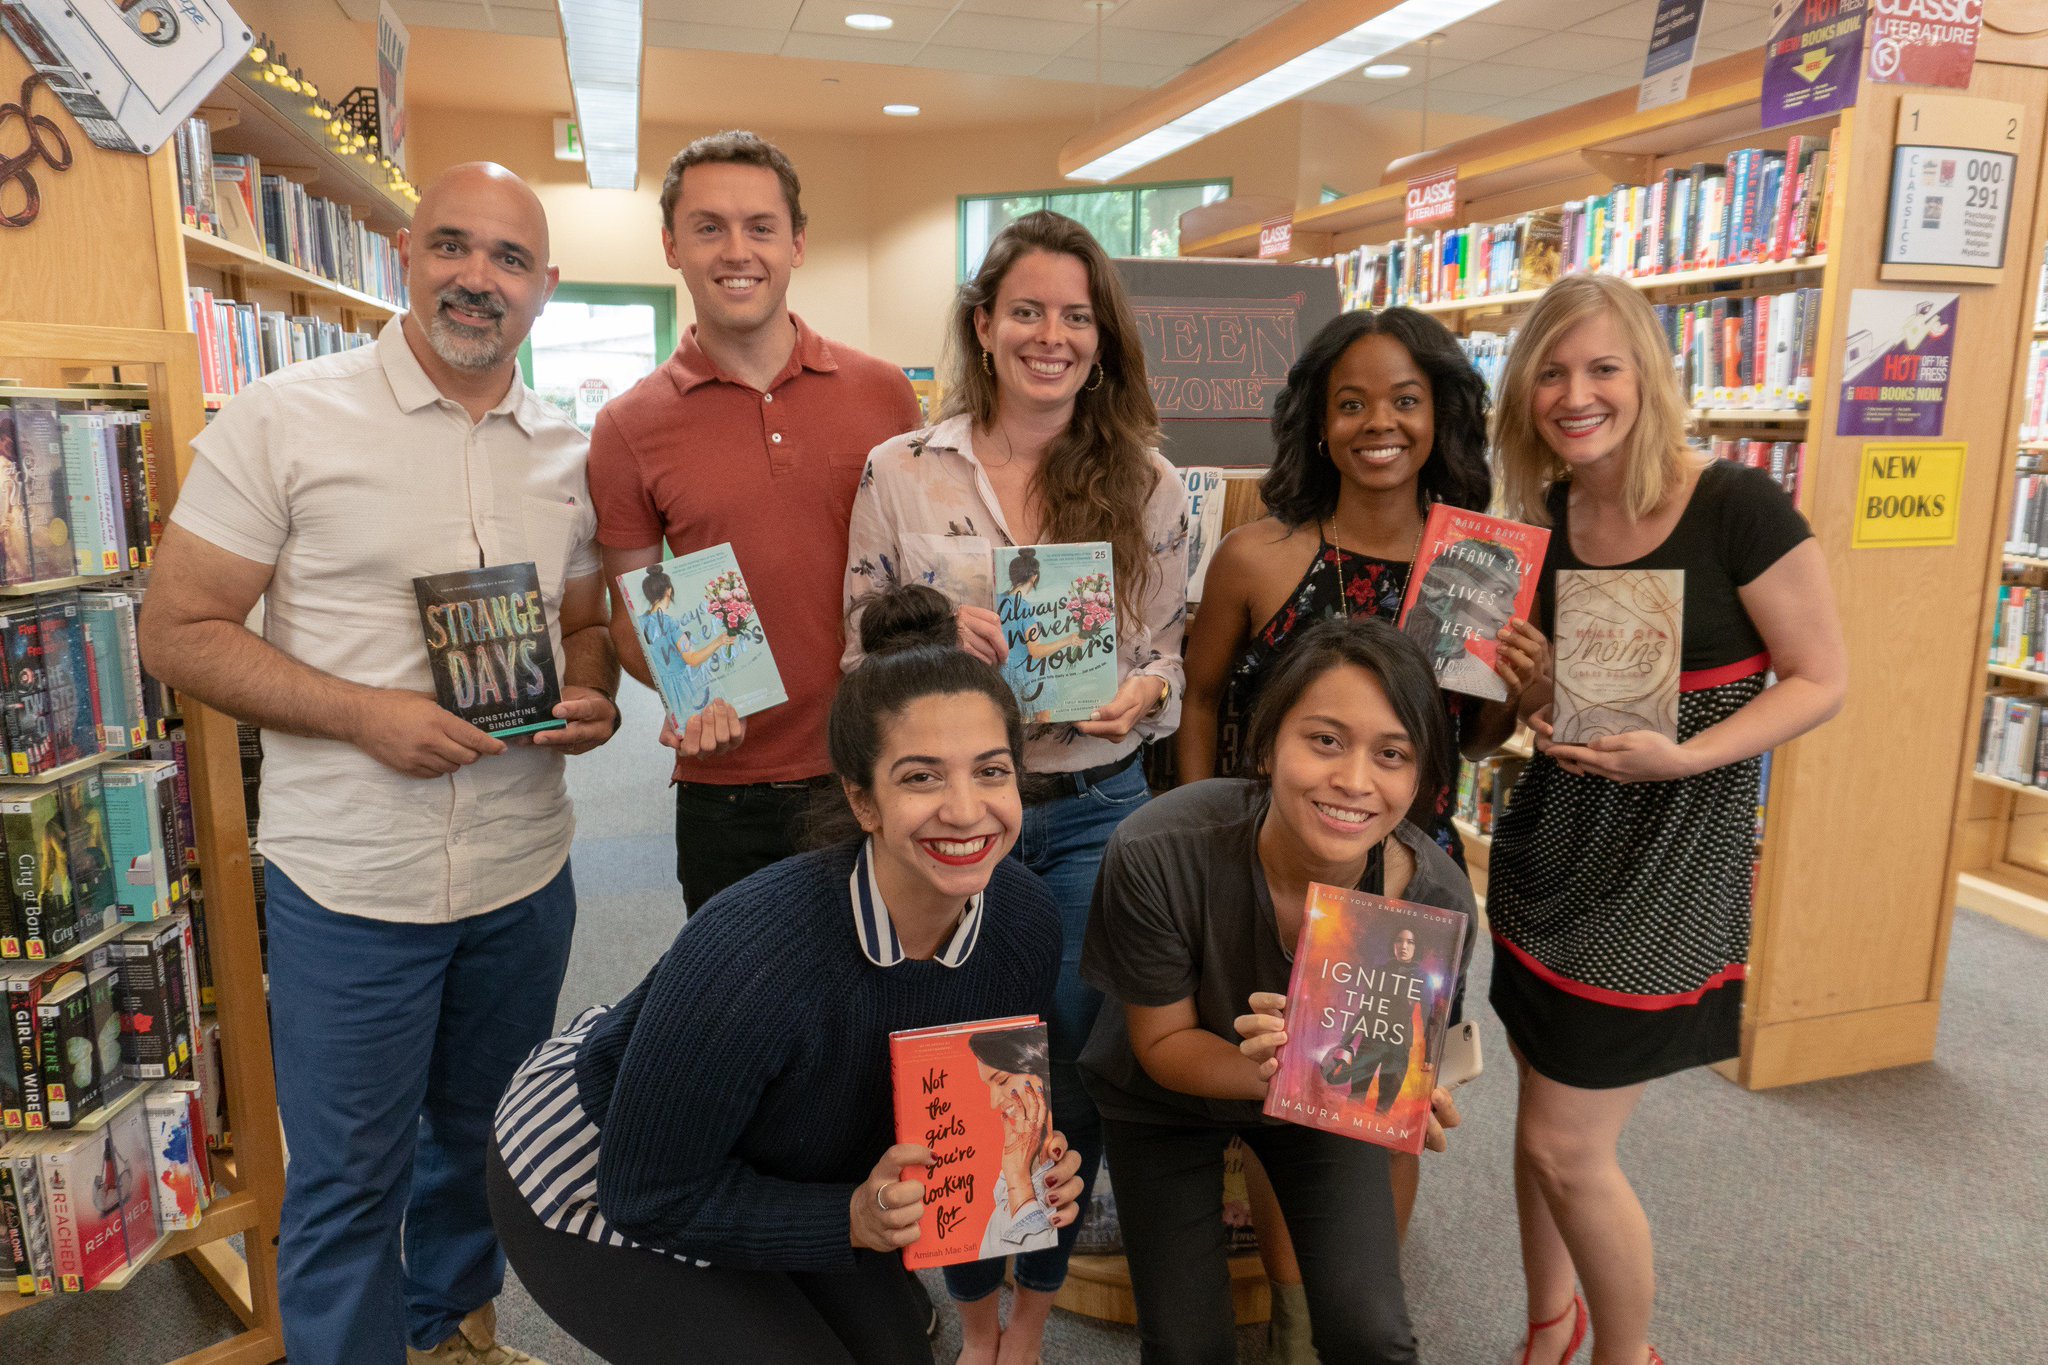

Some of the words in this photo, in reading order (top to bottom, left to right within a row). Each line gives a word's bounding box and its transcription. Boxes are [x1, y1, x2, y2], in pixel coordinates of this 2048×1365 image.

[1875, 0, 1980, 24] CLASSIC
[1801, 24, 1836, 48] BOOKS
[1874, 17, 1976, 45] LITERATURE
[1911, 109, 1920, 131] 1
[2006, 118, 2018, 140] 2
[1407, 178, 1456, 209] CLASSIC
[1965, 185, 1998, 210] 291
[1407, 200, 1455, 222] LITERATURE
[1261, 223, 1293, 246] CLASSIC
[1883, 354, 1921, 381] HOT
[1920, 367, 1948, 381] PRESS
[586, 395, 604, 403] EXIT
[1153, 376, 1264, 411] ZONE
[1880, 386, 1916, 401] BOOKS
[1871, 455, 1922, 479] NEW
[1866, 494, 1945, 519] BOOKS
[1455, 518, 1480, 532] DANA
[1496, 527, 1526, 541] DAVIS
[1094, 551, 1106, 560] 25
[1433, 541, 1496, 567] TIFFANY
[1505, 559, 1533, 576] SLY
[1448, 583, 1499, 606] LIVES
[427, 591, 546, 649] STRANGE
[1008, 615, 1082, 650] never
[1441, 620, 1484, 642] HERE
[1558, 610, 1666, 666] Thorns
[448, 639, 545, 709] DAYS
[1014, 634, 1114, 702] yours
[472, 707, 537, 725] CONSTANTINE
[489, 717, 524, 730] SINGER
[17, 854, 35, 886] City
[1322, 892, 1345, 901] KEEP
[1350, 897, 1373, 907] YOUR
[1378, 903, 1418, 917] ENEMIES
[1423, 913, 1453, 925] CLOSE
[52, 925, 74, 944] City
[1321, 958, 1424, 1001] IGNITE
[1345, 990, 1390, 1015] THE
[1320, 1007, 1405, 1045] STARS
[15, 1010, 31, 1044] GIRL
[24, 1073, 41, 1111] WIRE
[43, 1030, 61, 1073] TITHE
[922, 1067, 949, 1095] Not
[925, 1098, 951, 1120] the
[1281, 1098, 1340, 1121] MAURA
[1352, 1117, 1409, 1140] MILAN
[925, 1116, 966, 1150] girls
[926, 1144, 976, 1180] you're
[922, 1173, 974, 1206] looking
[52, 1193, 76, 1271] REACHED
[85, 1200, 150, 1255] REACHED
[936, 1204, 962, 1240] for
[9, 1228, 24, 1264] BLONDE
[914, 1247, 943, 1260] Aminah
[945, 1245, 963, 1258] Mac
